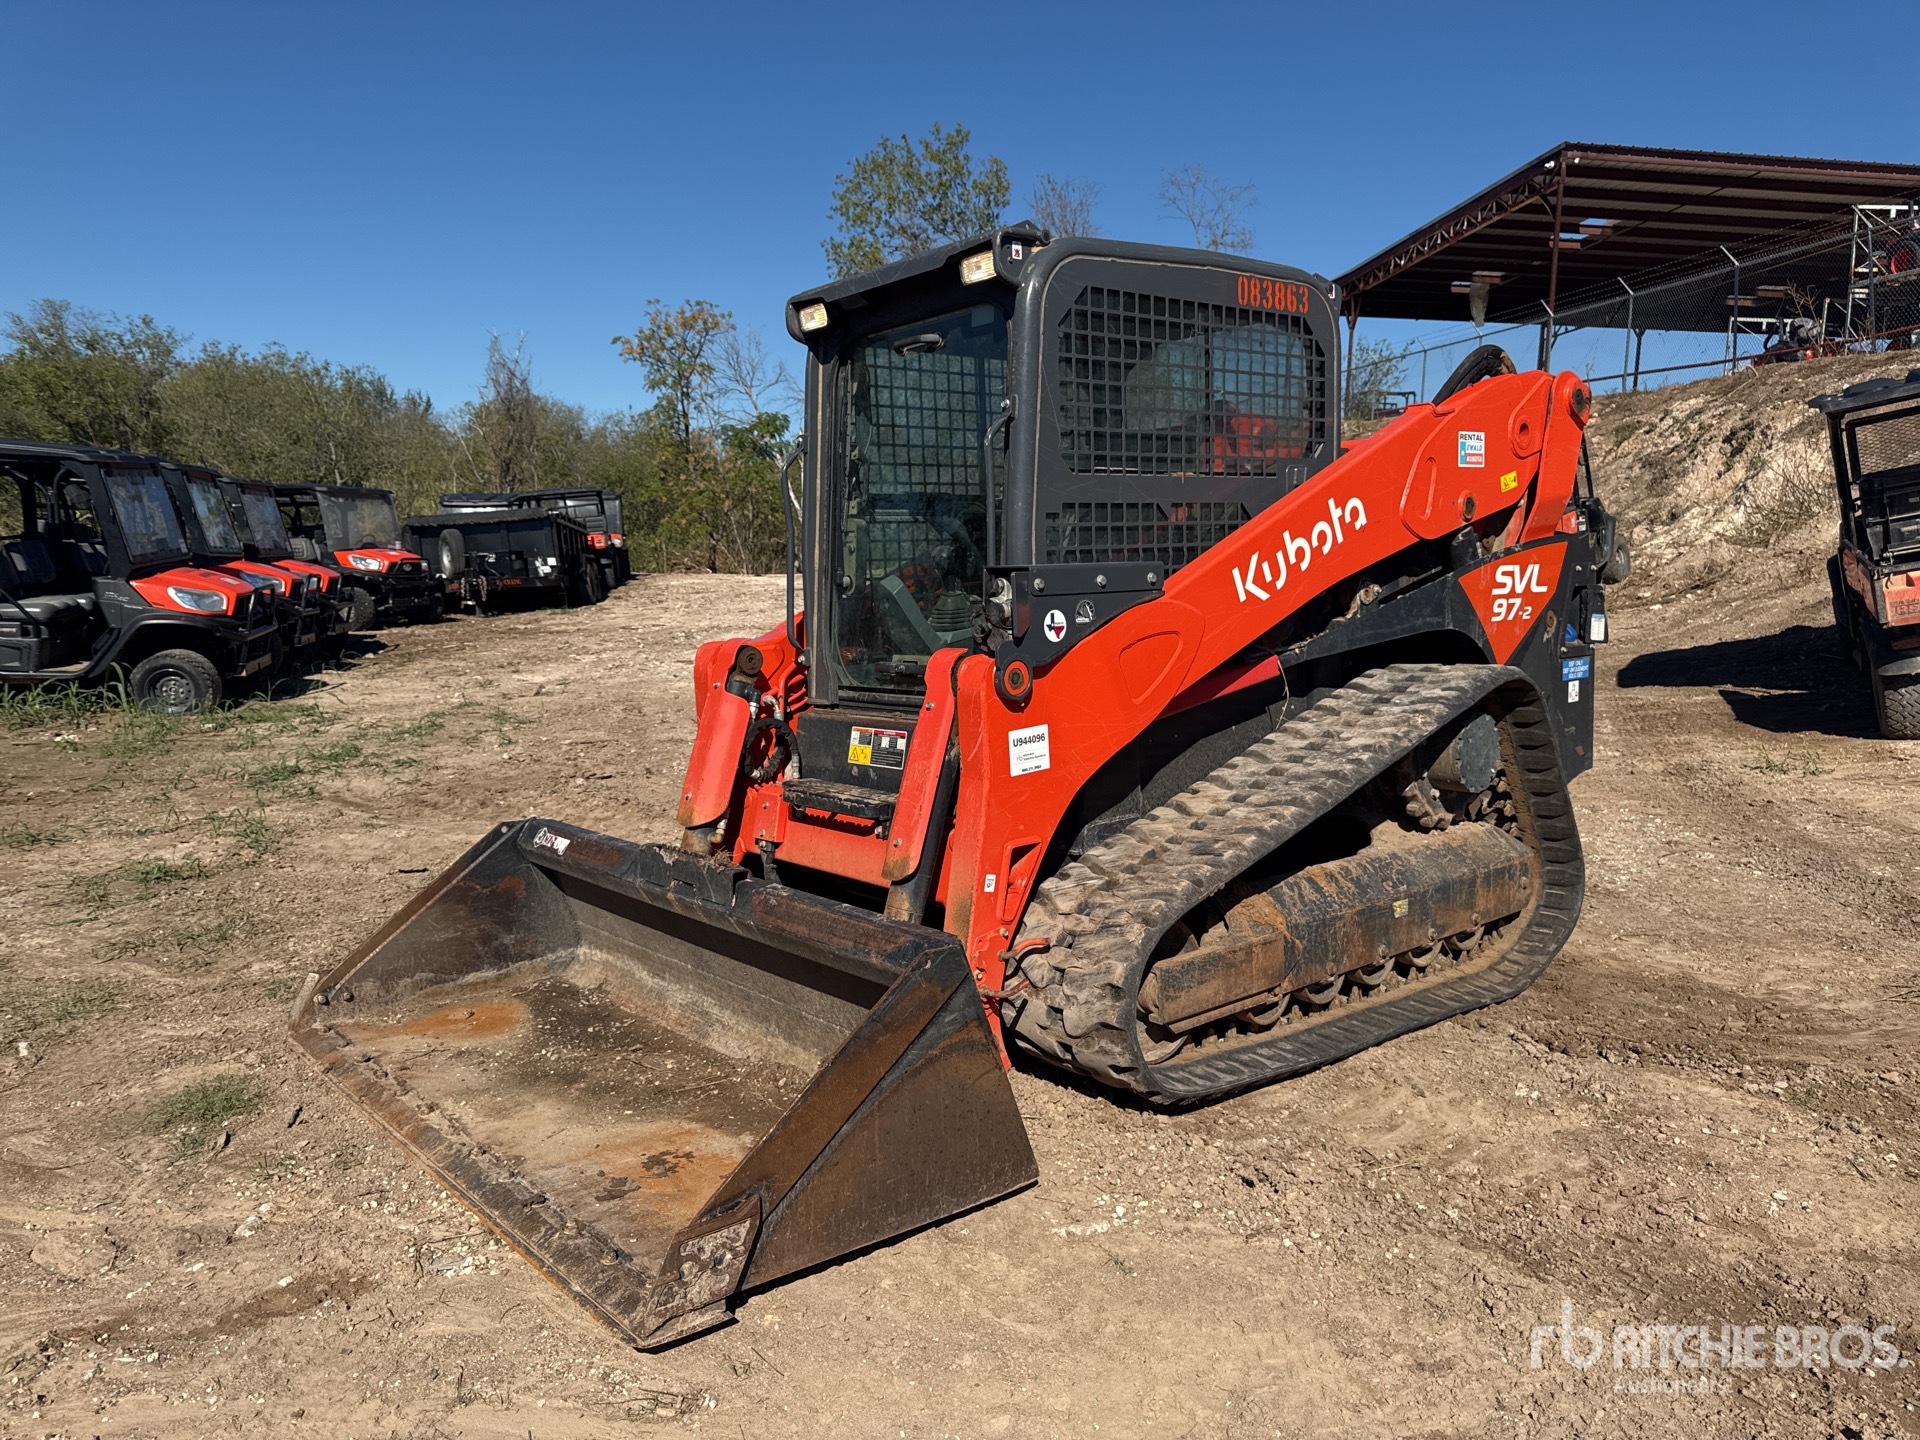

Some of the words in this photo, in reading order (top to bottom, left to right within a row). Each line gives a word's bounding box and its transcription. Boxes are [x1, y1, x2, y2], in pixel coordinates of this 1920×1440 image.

[1237, 276, 1309, 314] 083863
[1459, 433, 1483, 442] RENTAL
[1232, 497, 1367, 602] Kubota
[1491, 563, 1548, 595] SVL
[1013, 733, 1046, 747] U944096
